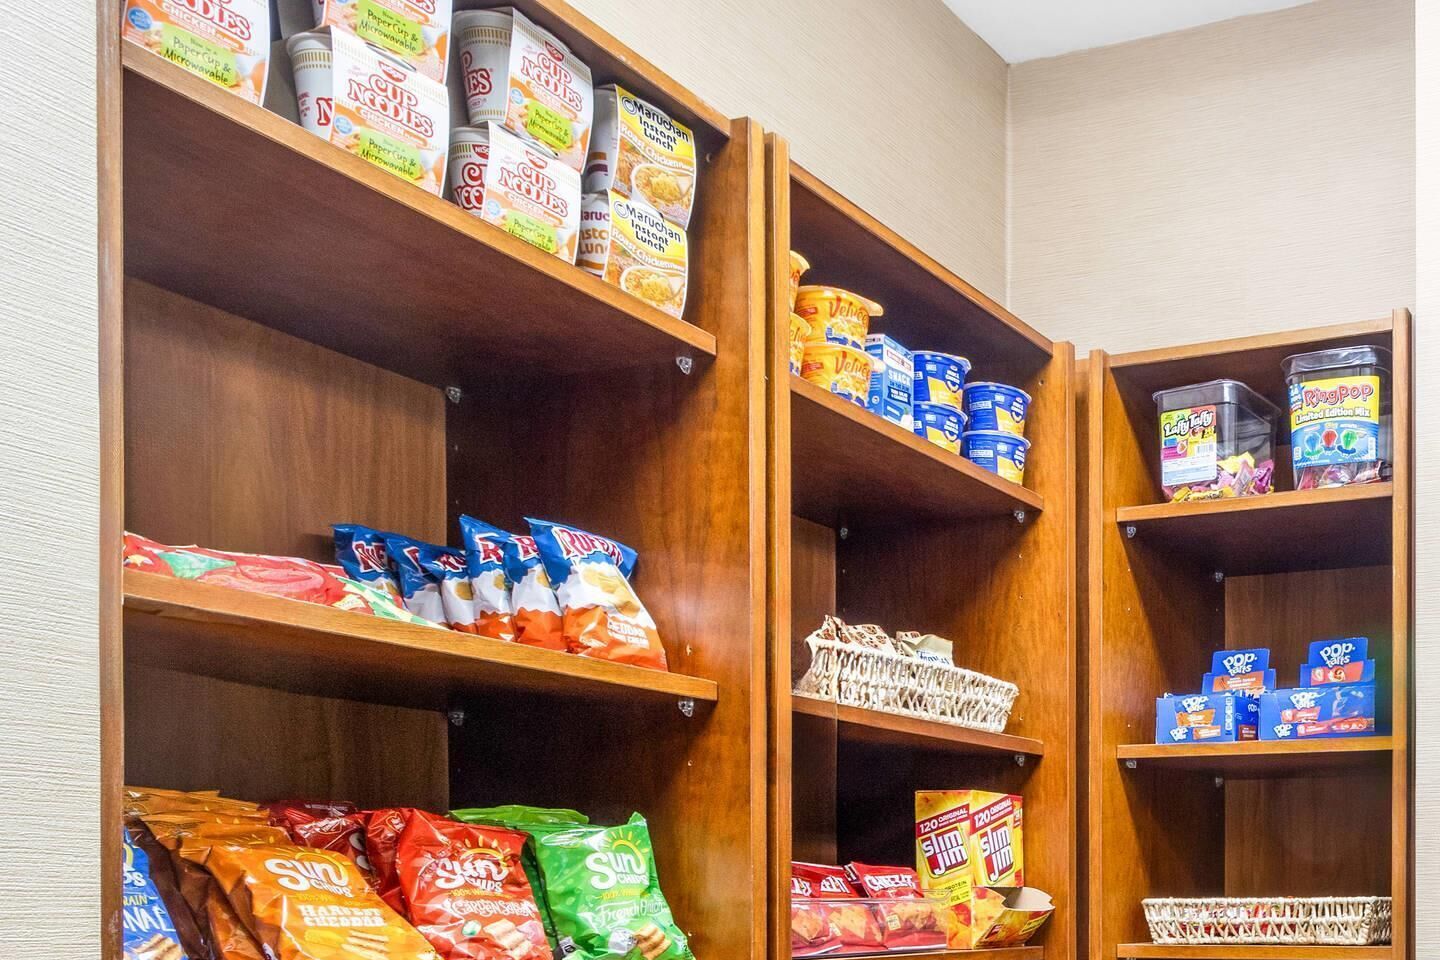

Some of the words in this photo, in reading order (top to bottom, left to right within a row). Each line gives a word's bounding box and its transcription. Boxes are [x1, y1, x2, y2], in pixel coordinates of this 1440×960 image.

[359, 20, 416, 53] Microwavable
[367, 9, 392, 28] Paper
[391, 22, 410, 38] Cup
[163, 48, 229, 86] Microwavable
[173, 36, 203, 57] Paper
[200, 51, 221, 68] Cup
[521, 56, 583, 112] NOODLES
[537, 53, 573, 84] CUP
[368, 74, 418, 107] CUP
[347, 78, 434, 137] NOODLES
[633, 99, 689, 144] Maruchan
[639, 116, 677, 145] Instant
[643, 128, 674, 152] Lunch
[368, 138, 394, 157] Paper
[498, 166, 569, 218] NOODLES
[517, 161, 557, 192] CUP
[626, 203, 681, 243] Maruchan
[631, 219, 669, 246] Instant
[635, 231, 665, 253] Lunch
[1304, 387, 1339, 408] Ring
[1164, 419, 1190, 438] Laffy
[1188, 409, 1213, 427] Taffy
[1296, 411, 1325, 425] Limited
[1325, 407, 1354, 418] Edition
[1355, 406, 1371, 418] Mix
[919, 819, 939, 834] 120
[938, 808, 968, 823] ORIGINAL
[974, 809, 991, 829] 120
[990, 798, 1012, 815] ORIGINAL
[264, 857, 349, 891] Sun
[435, 857, 509, 890] Sun
[586, 851, 647, 890] Sun
